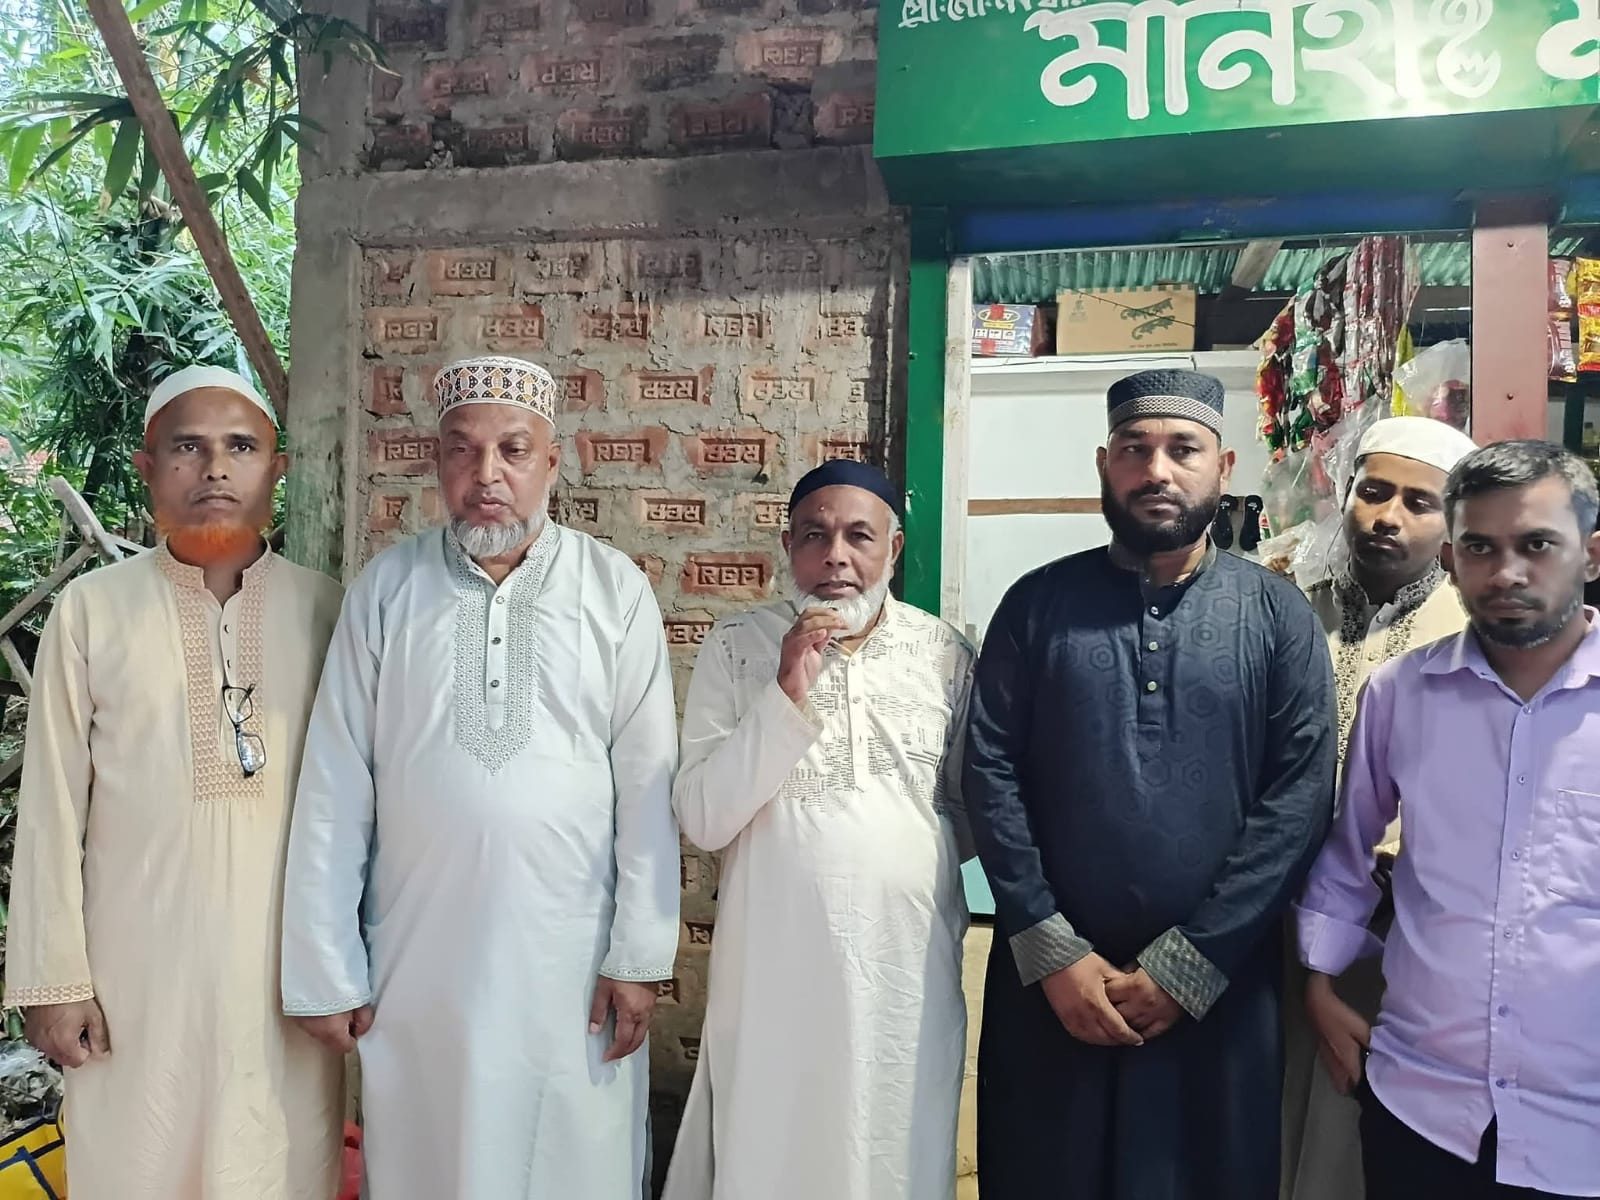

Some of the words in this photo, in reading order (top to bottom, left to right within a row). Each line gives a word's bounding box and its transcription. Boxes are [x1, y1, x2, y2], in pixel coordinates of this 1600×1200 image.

[541, 62, 596, 84] REP
[841, 106, 875, 126] RE
[386, 322, 433, 338] REP
[644, 381, 693, 399] REP
[386, 442, 434, 460] REP
[593, 442, 647, 462] REP
[704, 443, 760, 463] REP
[648, 507, 700, 523] REP
[702, 566, 760, 586] REP
